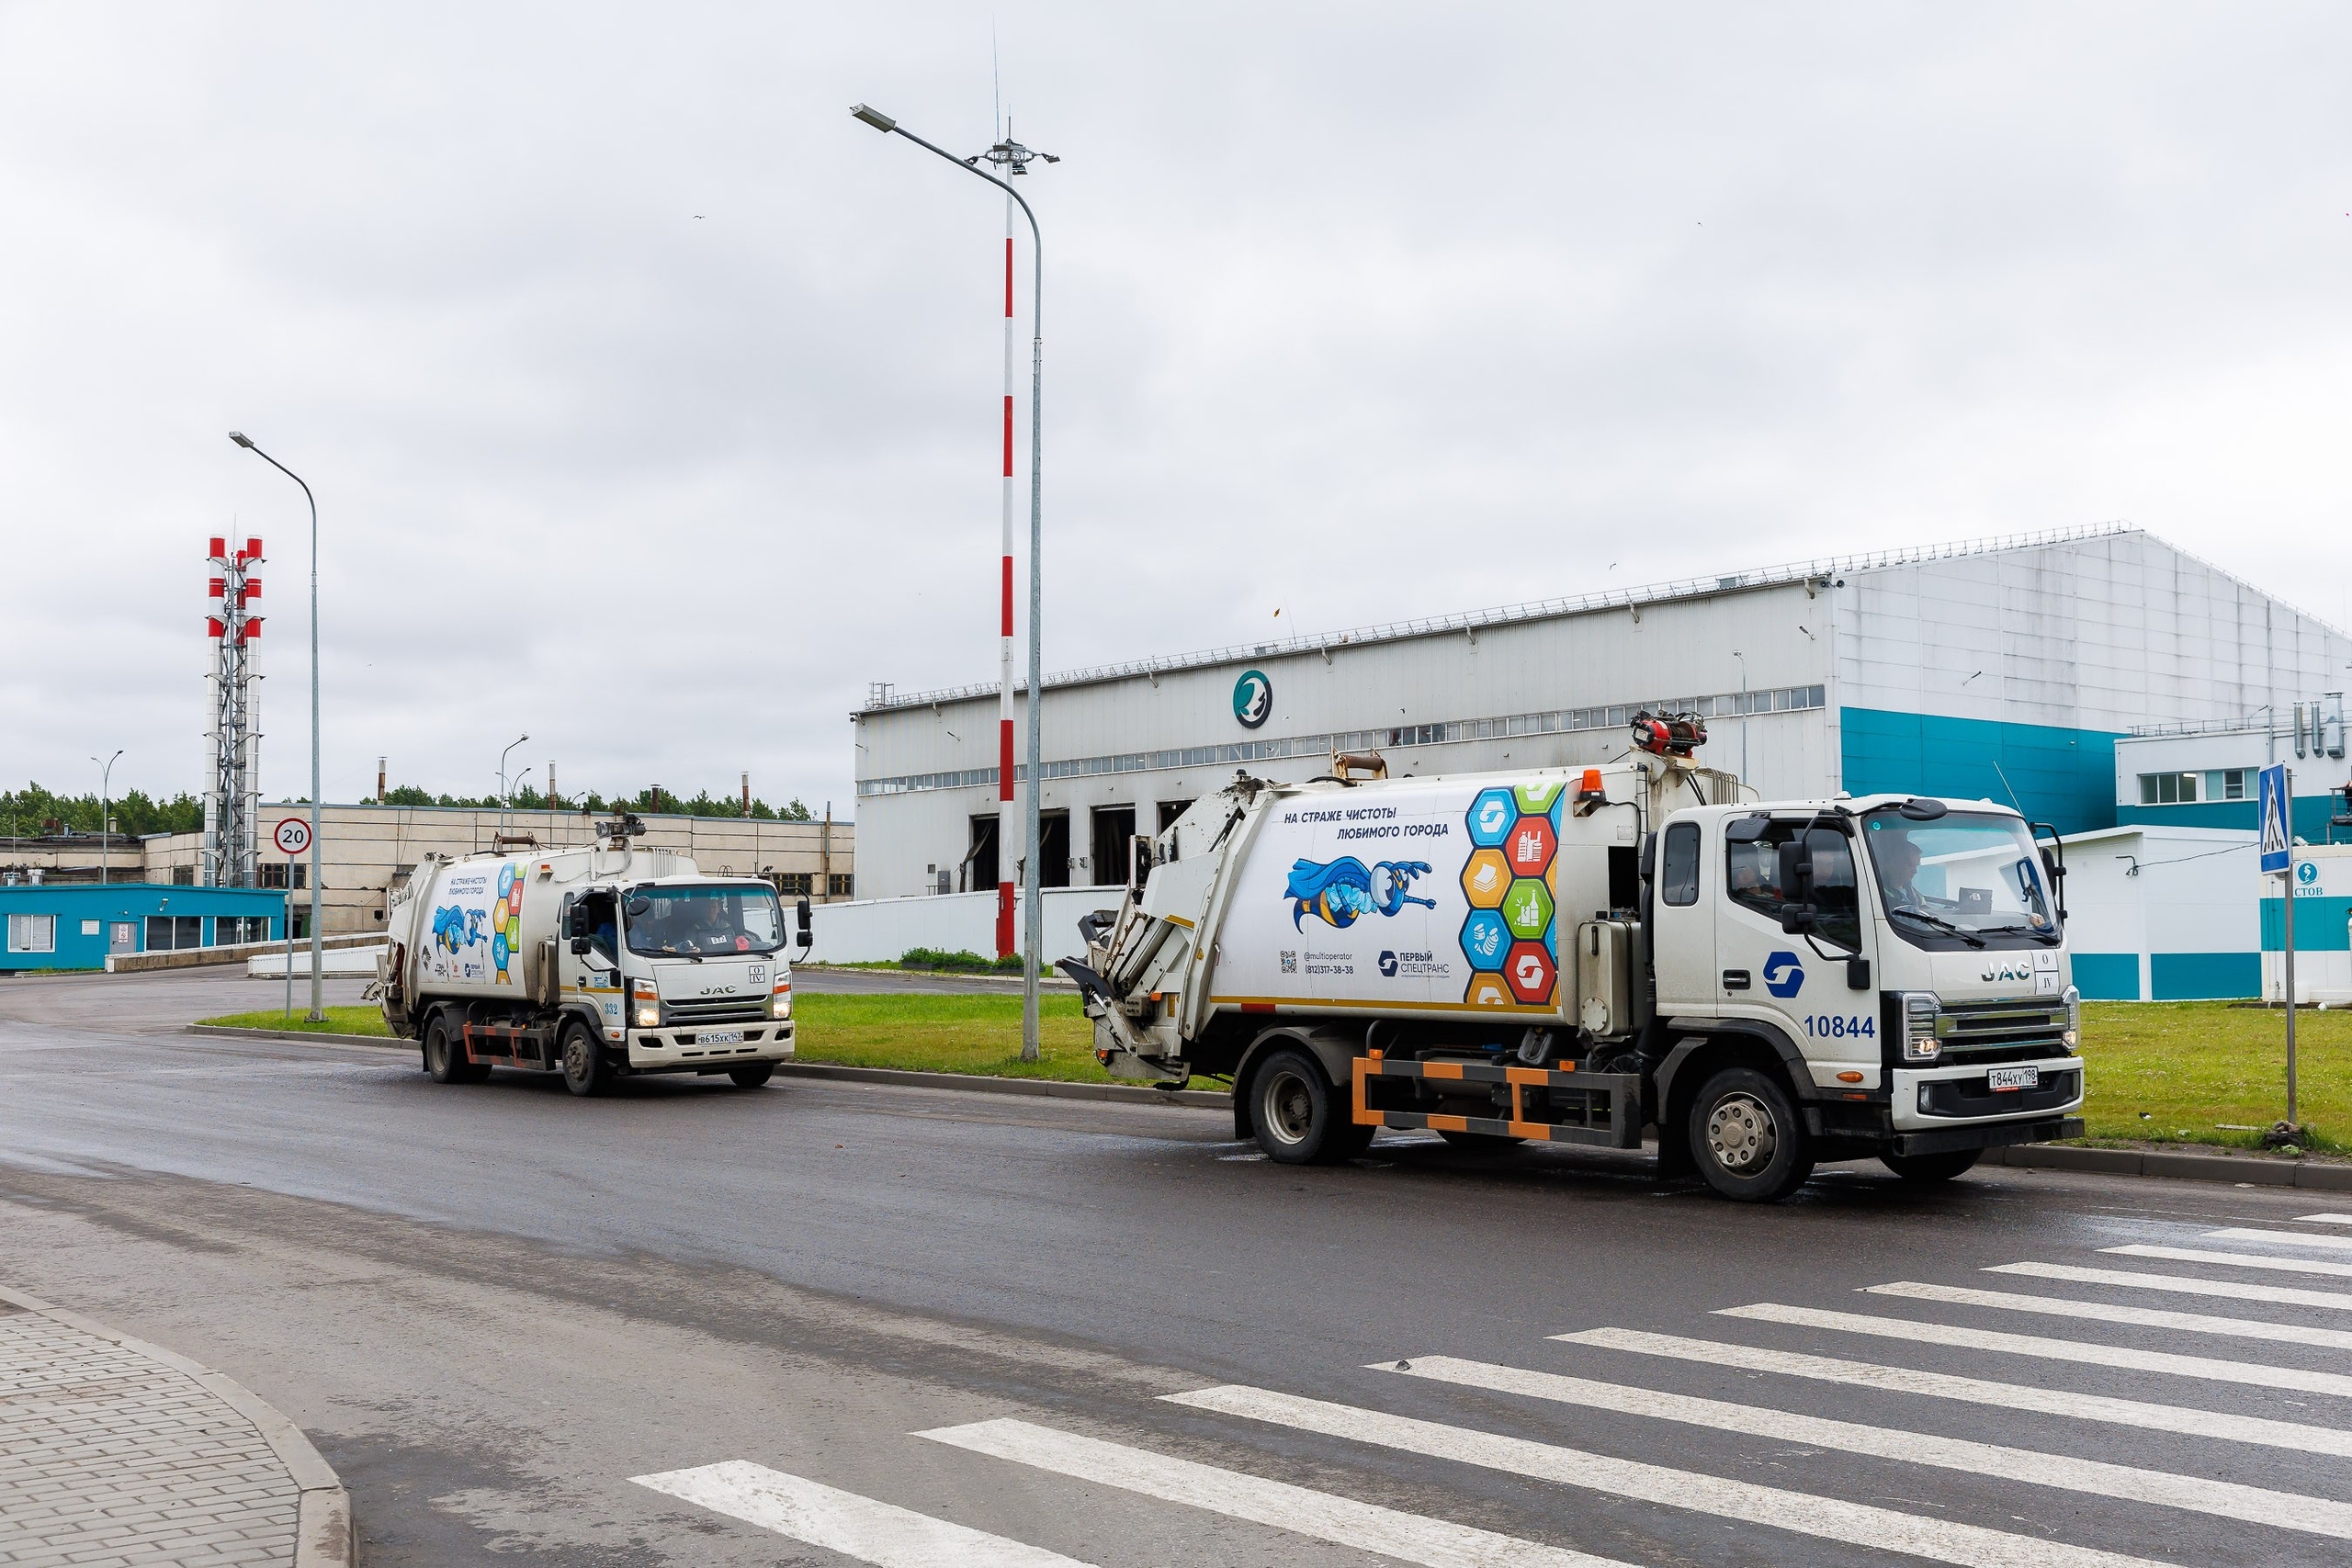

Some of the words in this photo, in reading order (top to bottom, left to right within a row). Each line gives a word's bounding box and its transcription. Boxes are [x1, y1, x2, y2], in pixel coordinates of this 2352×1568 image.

[1284, 813, 1297, 823] НА
[1301, 810, 1342, 822] СТРАЖЕ
[1346, 807, 1396, 820] ЧИСТОТЫ
[282, 829, 304, 843] 20
[1337, 825, 1400, 840] ЛЮБИМОГО
[1403, 823, 1449, 837] ГОРОДА
[1303, 952, 1352, 962] @multioperator
[1399, 951, 1433, 962] ПЕРВЫЙ
[1305, 965, 1353, 975] (812)317-38-38
[1400, 963, 1449, 974] СПЕЦТРАНС
[1981, 961, 2030, 982] JAC
[2043, 977, 2052, 988] IV
[700, 983, 736, 995] JAC
[605, 1002, 617, 1015] 332
[1804, 1015, 1875, 1038] 10844
